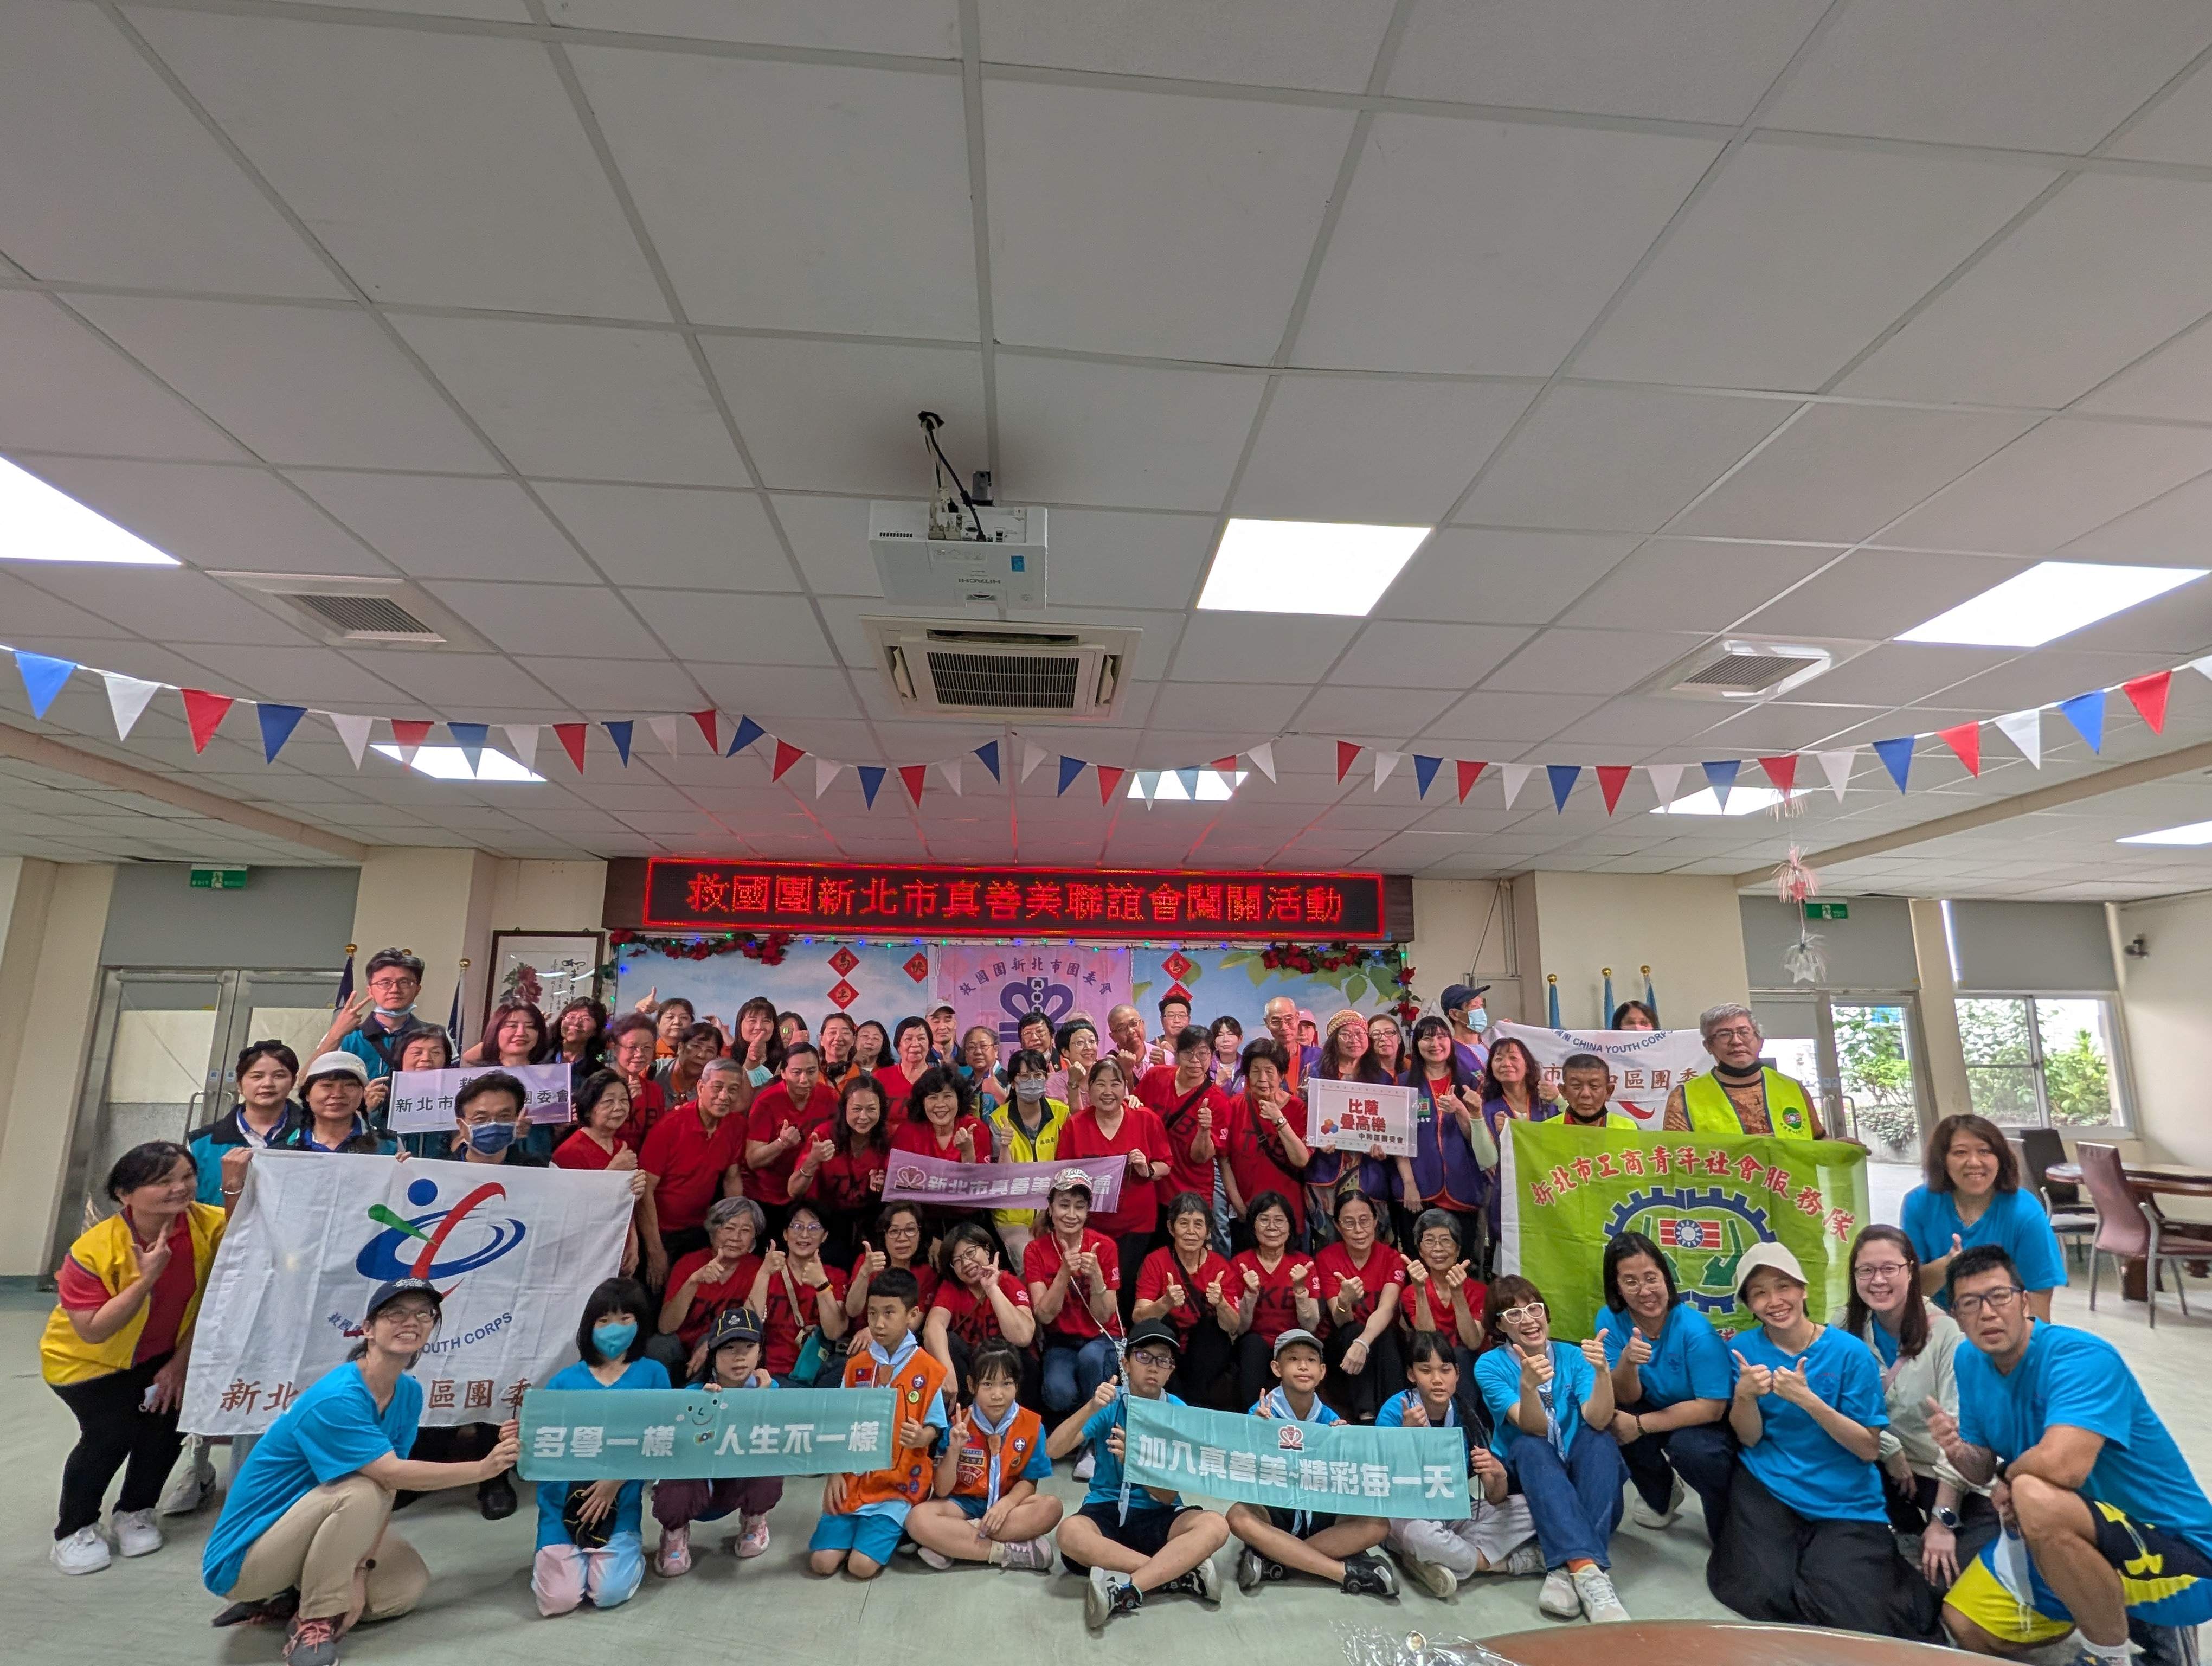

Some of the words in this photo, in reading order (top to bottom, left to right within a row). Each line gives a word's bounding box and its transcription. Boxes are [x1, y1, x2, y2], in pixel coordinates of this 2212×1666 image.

[687, 872, 1343, 922] 救國團新北市真善美聯誼會闖關活動
[1573, 1037, 1603, 1053] CHINA
[1606, 1042, 1641, 1054] YOUTH
[1348, 1098, 1379, 1116] 比薩
[927, 1174, 1113, 1196] 新北市真善美會
[421, 1336, 461, 1354] OUTH
[464, 1312, 512, 1344] CORPS
[533, 1425, 676, 1458] 多學一樣
[713, 1420, 880, 1457] 人生不一樣
